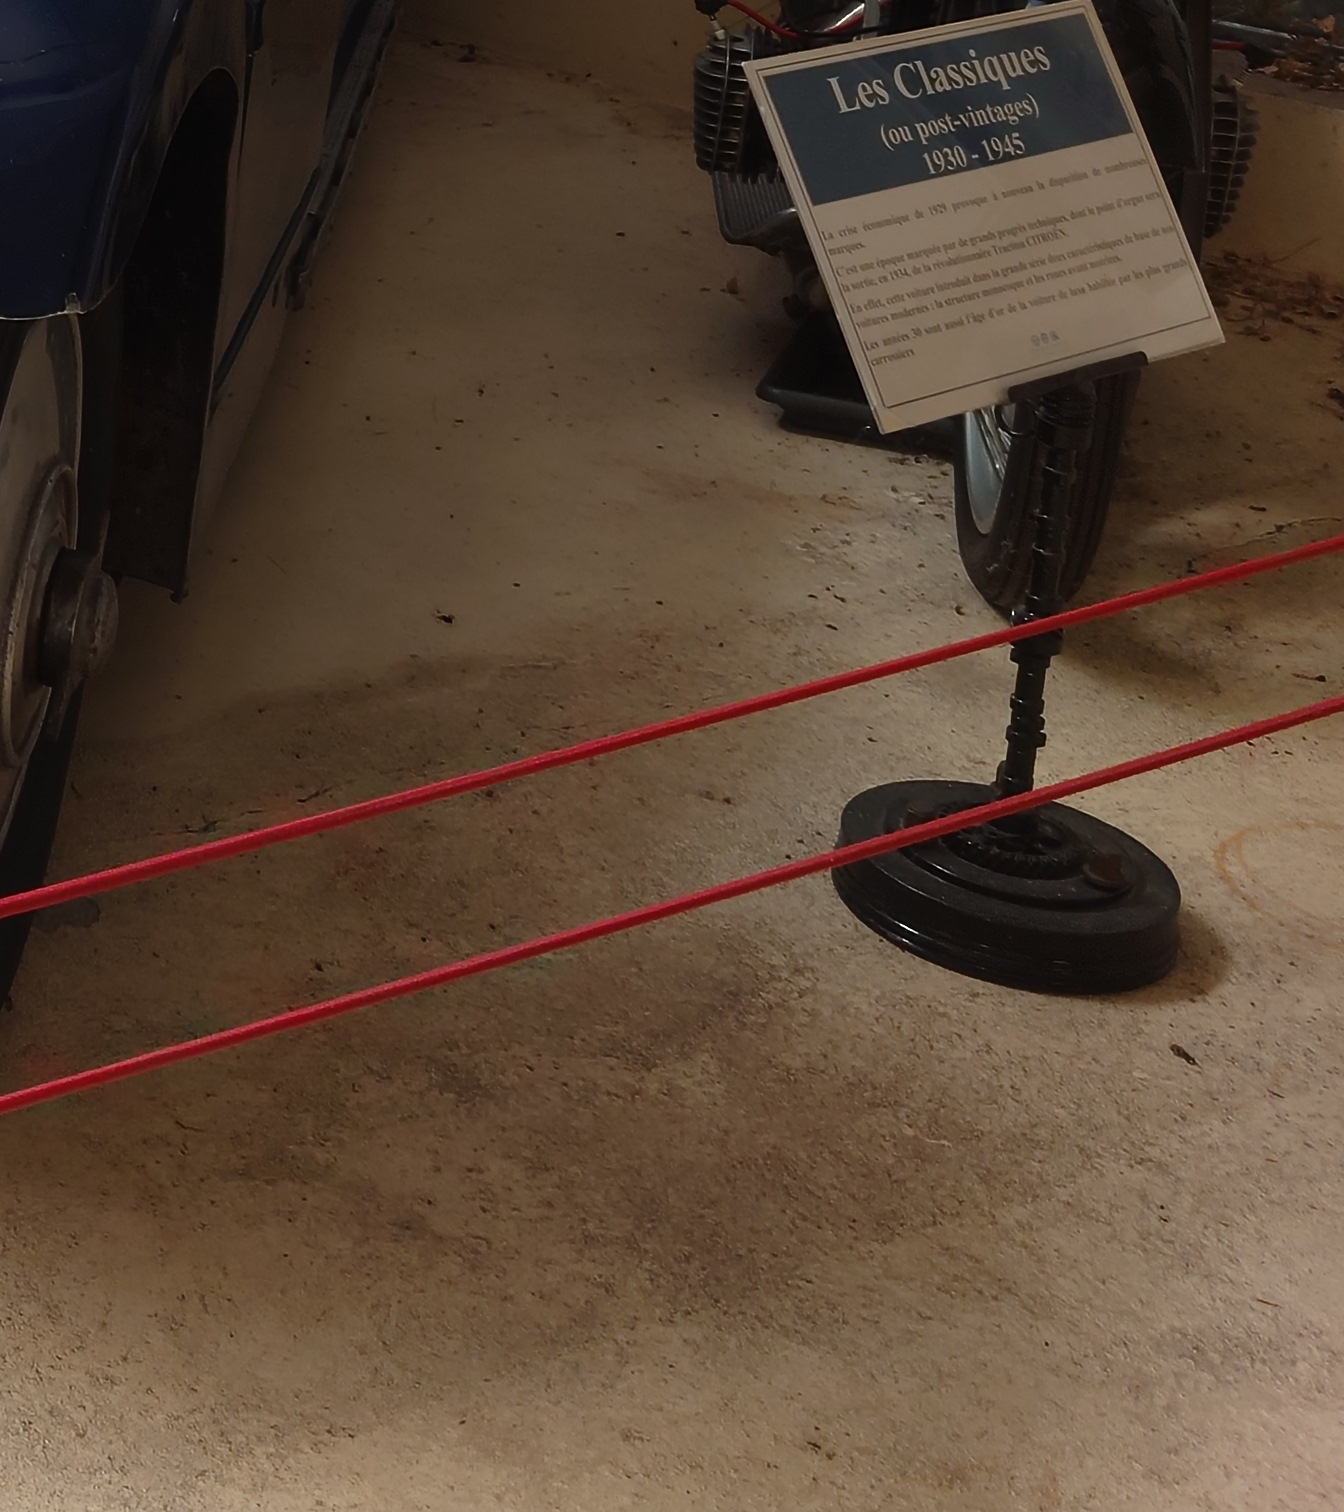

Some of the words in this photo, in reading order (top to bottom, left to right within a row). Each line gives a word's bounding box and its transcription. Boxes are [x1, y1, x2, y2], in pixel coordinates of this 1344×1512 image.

[826, 76, 889, 113] Les
[893, 46, 1050, 98] Classiques
[880, 124, 913, 150] (ou
[914, 92, 1039, 144] post-vintages)
[922, 145, 966, 173] 1930
[981, 132, 1025, 160] 1945
